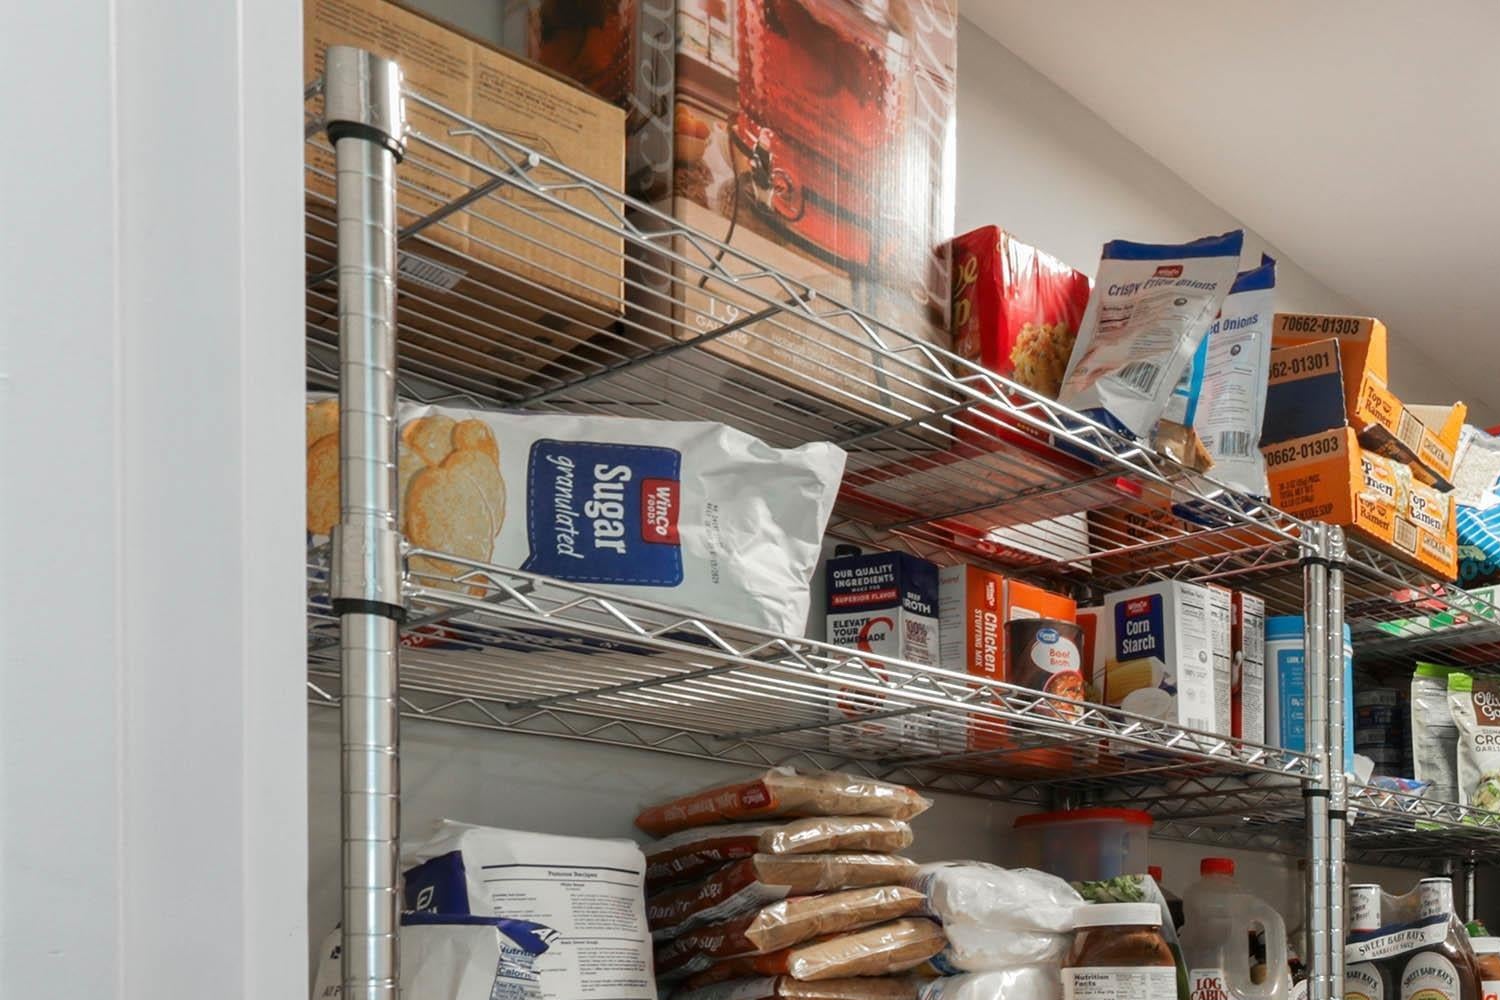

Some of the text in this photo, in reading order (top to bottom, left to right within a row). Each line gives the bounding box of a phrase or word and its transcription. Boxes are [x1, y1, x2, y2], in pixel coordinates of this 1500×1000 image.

[1109, 282, 1139, 297] Crispy
[1223, 314, 1259, 332] Onions
[1282, 316, 1360, 335] 70662-01303
[1367, 386, 1382, 407] Top
[1365, 400, 1393, 428] Ramen
[546, 453, 584, 559] granulated
[584, 463, 632, 555] Sugar
[646, 493, 656, 526] FOODS
[655, 486, 671, 537] WinCo
[1359, 506, 1390, 531] Ramen
[833, 563, 894, 580] OUR QUALITY
[835, 574, 895, 589] INGREDIENTS
[833, 629, 859, 638] YOUR
[1126, 619, 1150, 636] Corn
[833, 633, 887, 645] HOMEADE
[974, 608, 984, 667] STUFFING MIX
[984, 612, 998, 673] Chicken
[1122, 634, 1156, 654] Starch
[1074, 980, 1097, 988] Facts
[1196, 977, 1222, 991] LOG
